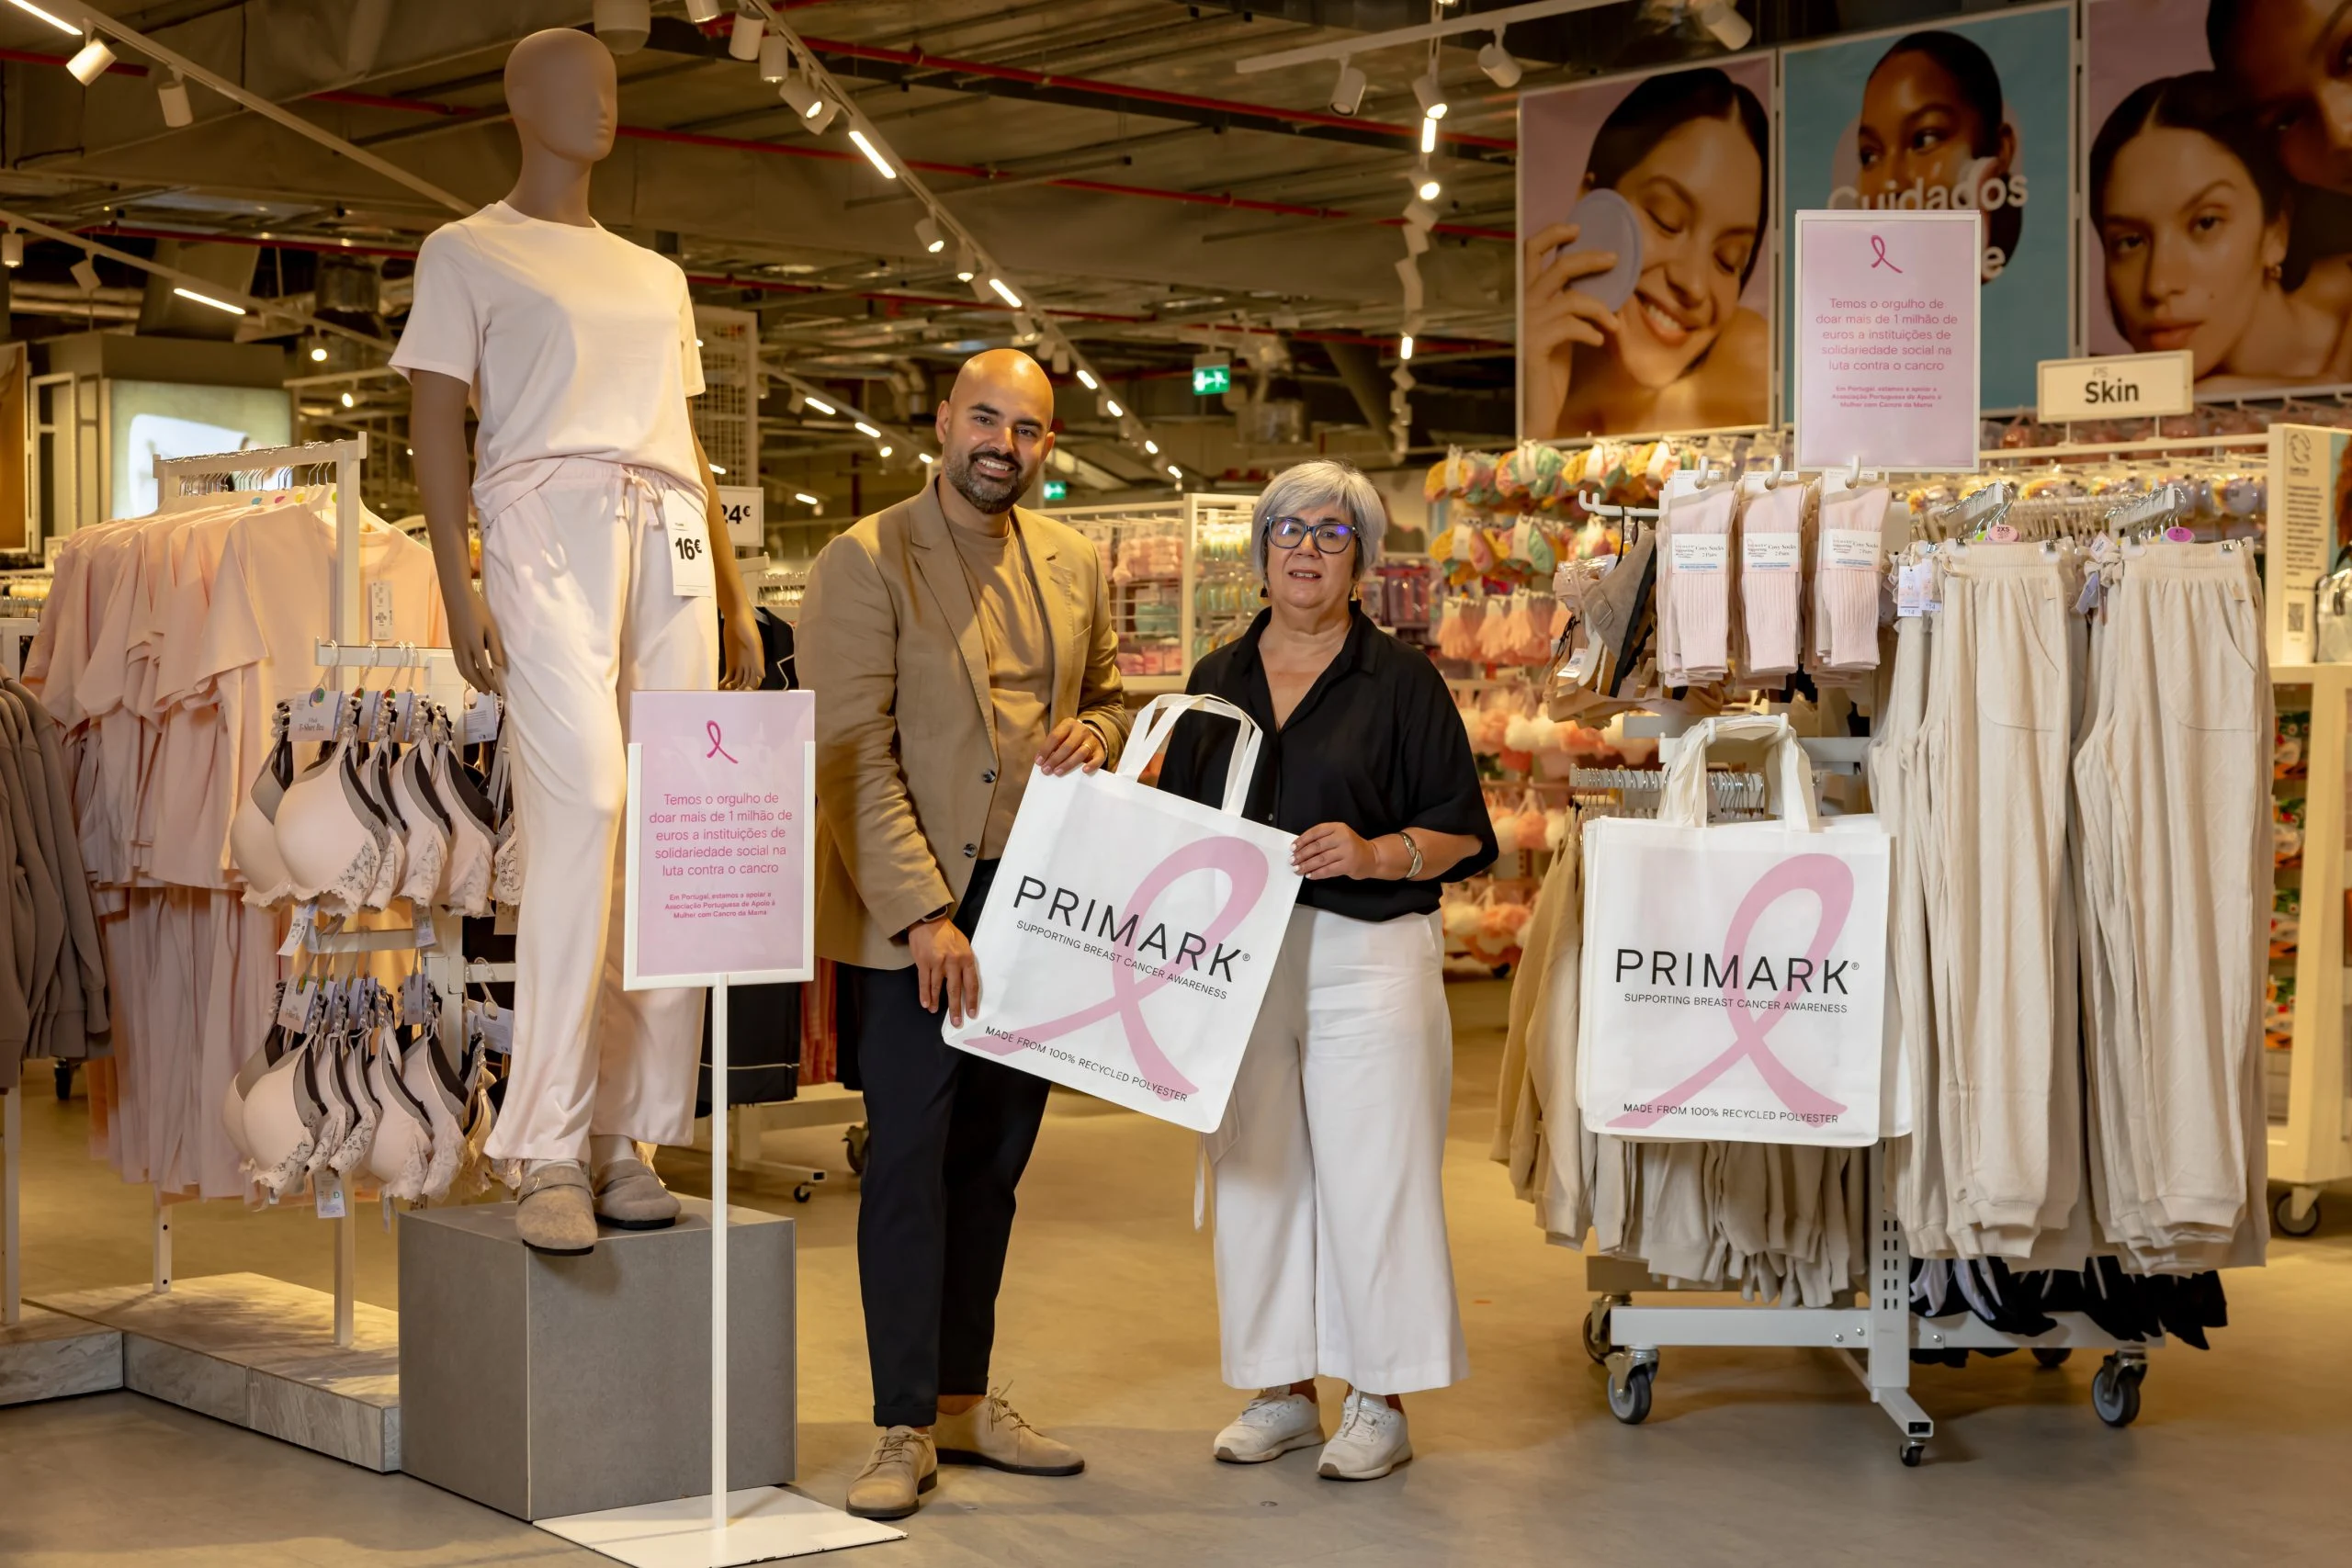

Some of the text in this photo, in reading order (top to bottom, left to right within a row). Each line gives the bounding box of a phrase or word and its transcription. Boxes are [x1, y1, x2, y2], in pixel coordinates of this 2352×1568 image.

[1830, 299, 1944, 310] Temos o orgulho de
[1815, 314, 1957, 324] doar mais de 1 milhão de
[1823, 330, 1951, 342] euros a instituições de
[1822, 345, 1897, 355] solidariedade
[1902, 345, 1934, 355] social
[1829, 360, 1849, 370] luta
[1853, 361, 1889, 370] contra
[1905, 362, 1944, 370] cancro
[2085, 378, 2139, 403] Skin
[675, 537, 702, 560] 16€
[664, 793, 778, 807] Temos o orgulho de
[650, 810, 792, 823] doar mais de 1 milhão de
[656, 827, 786, 841] euros a instituições de
[655, 845, 786, 859] solidariedade social na
[662, 864, 778, 876] luta contra o cancro
[1016, 919, 1227, 999] SUPPORTING BREAST CANCER AWARENESS
[1624, 993, 1848, 1013] SUPPORTING BREAST CANCER AWARENESS
[985, 1026, 1188, 1102] MADE FROM 100% RECYCLED POLYESTER
[1623, 1103, 1838, 1123] MADE FROM 100% RECYCLED POLYESTER
